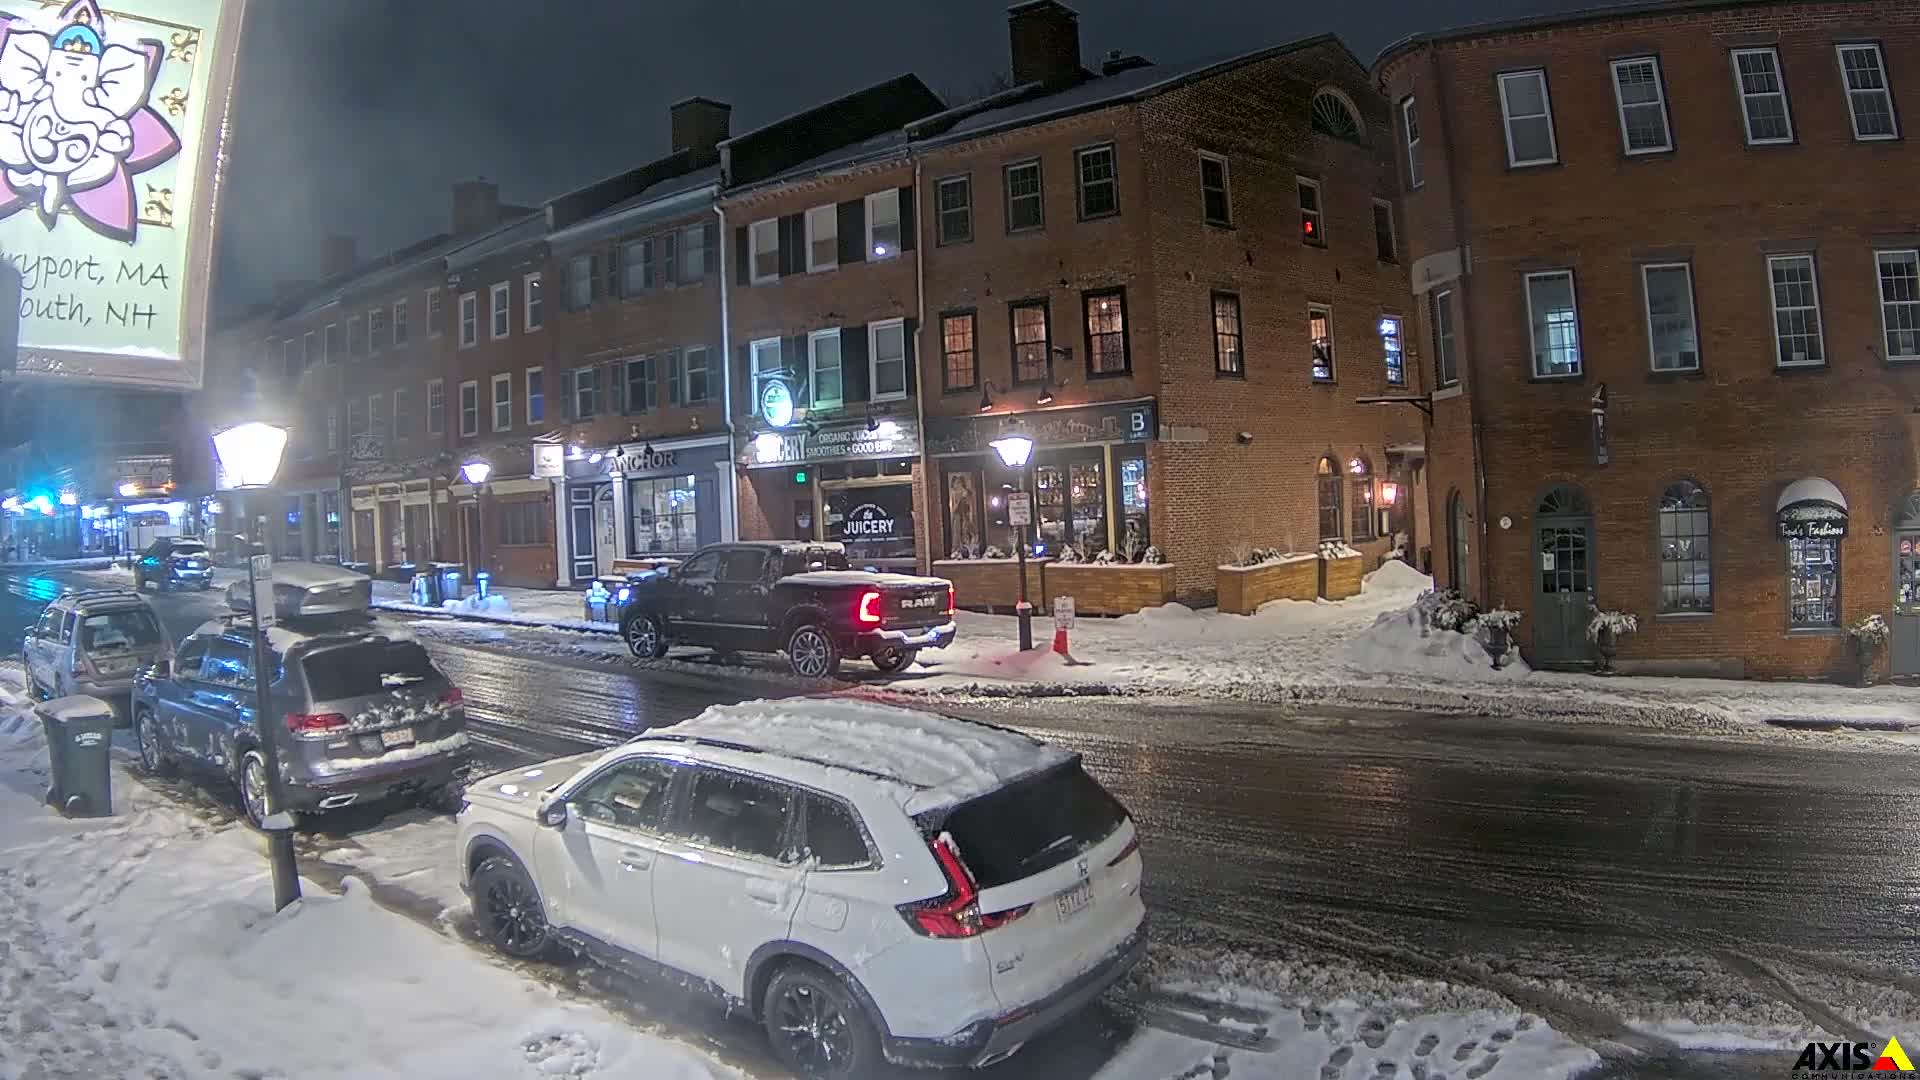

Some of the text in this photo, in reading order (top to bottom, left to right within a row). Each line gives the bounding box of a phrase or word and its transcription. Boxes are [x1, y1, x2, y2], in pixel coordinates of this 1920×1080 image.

[1, 252, 169, 291] ryport, MA
[105, 300, 158, 329] NH
[1131, 412, 1145, 432] B
[818, 431, 850, 445] ORGANIC
[806, 443, 846, 458] SMOOTHIES
[851, 441, 875, 454] GOOD
[609, 453, 675, 472] ANCHOR
[843, 518, 895, 535] JUICERY
[901, 597, 935, 608] RAM
